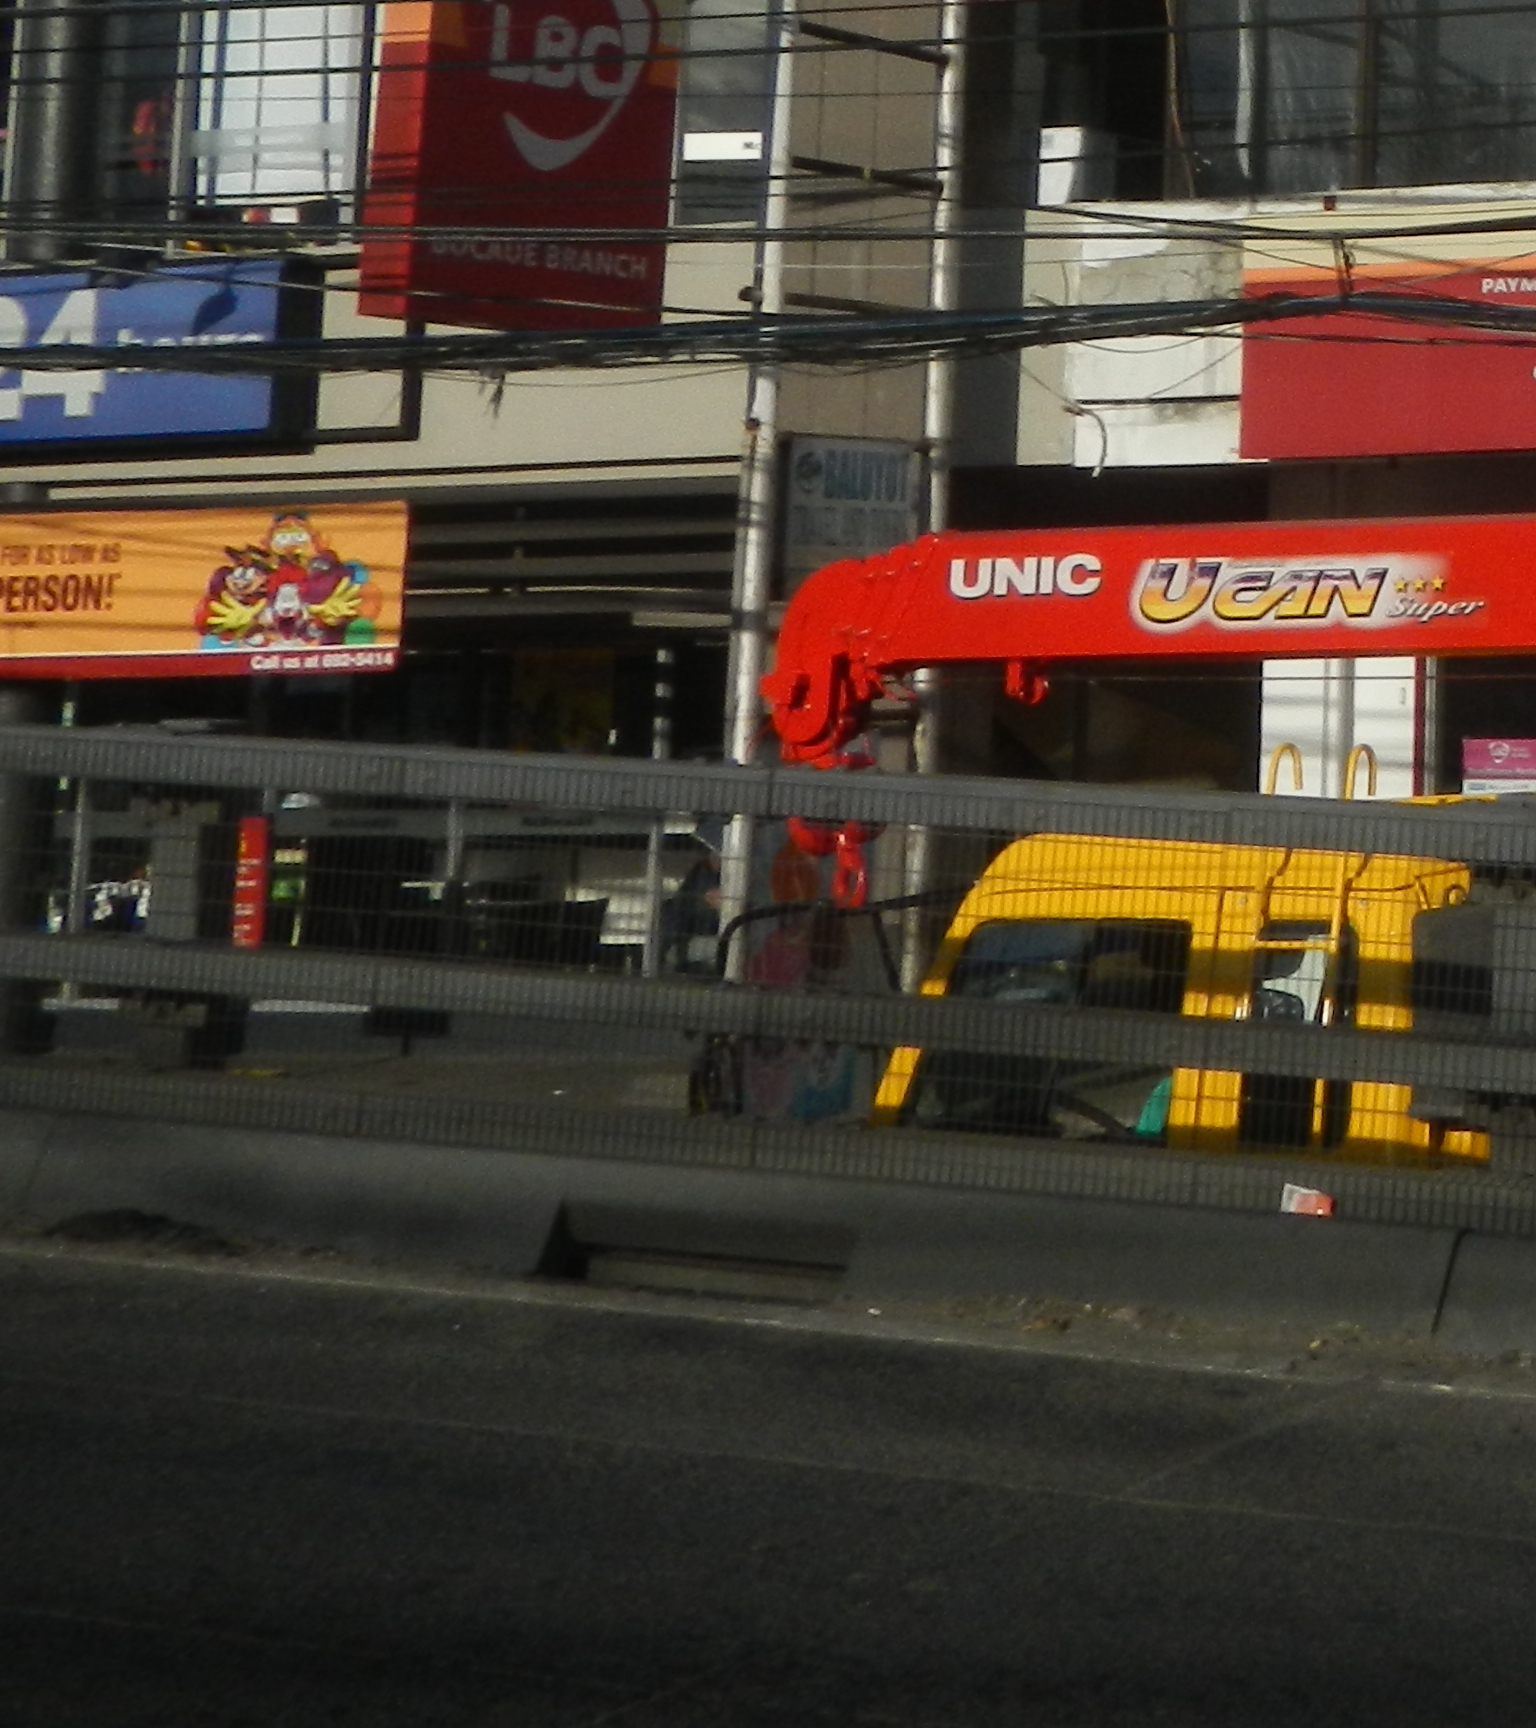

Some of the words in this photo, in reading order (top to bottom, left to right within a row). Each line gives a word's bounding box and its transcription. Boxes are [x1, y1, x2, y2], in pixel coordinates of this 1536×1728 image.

[488, 4, 625, 99] LBC
[545, 244, 648, 280] BRANCH
[949, 553, 1102, 600] UNIC
[1386, 597, 1485, 624] Super
